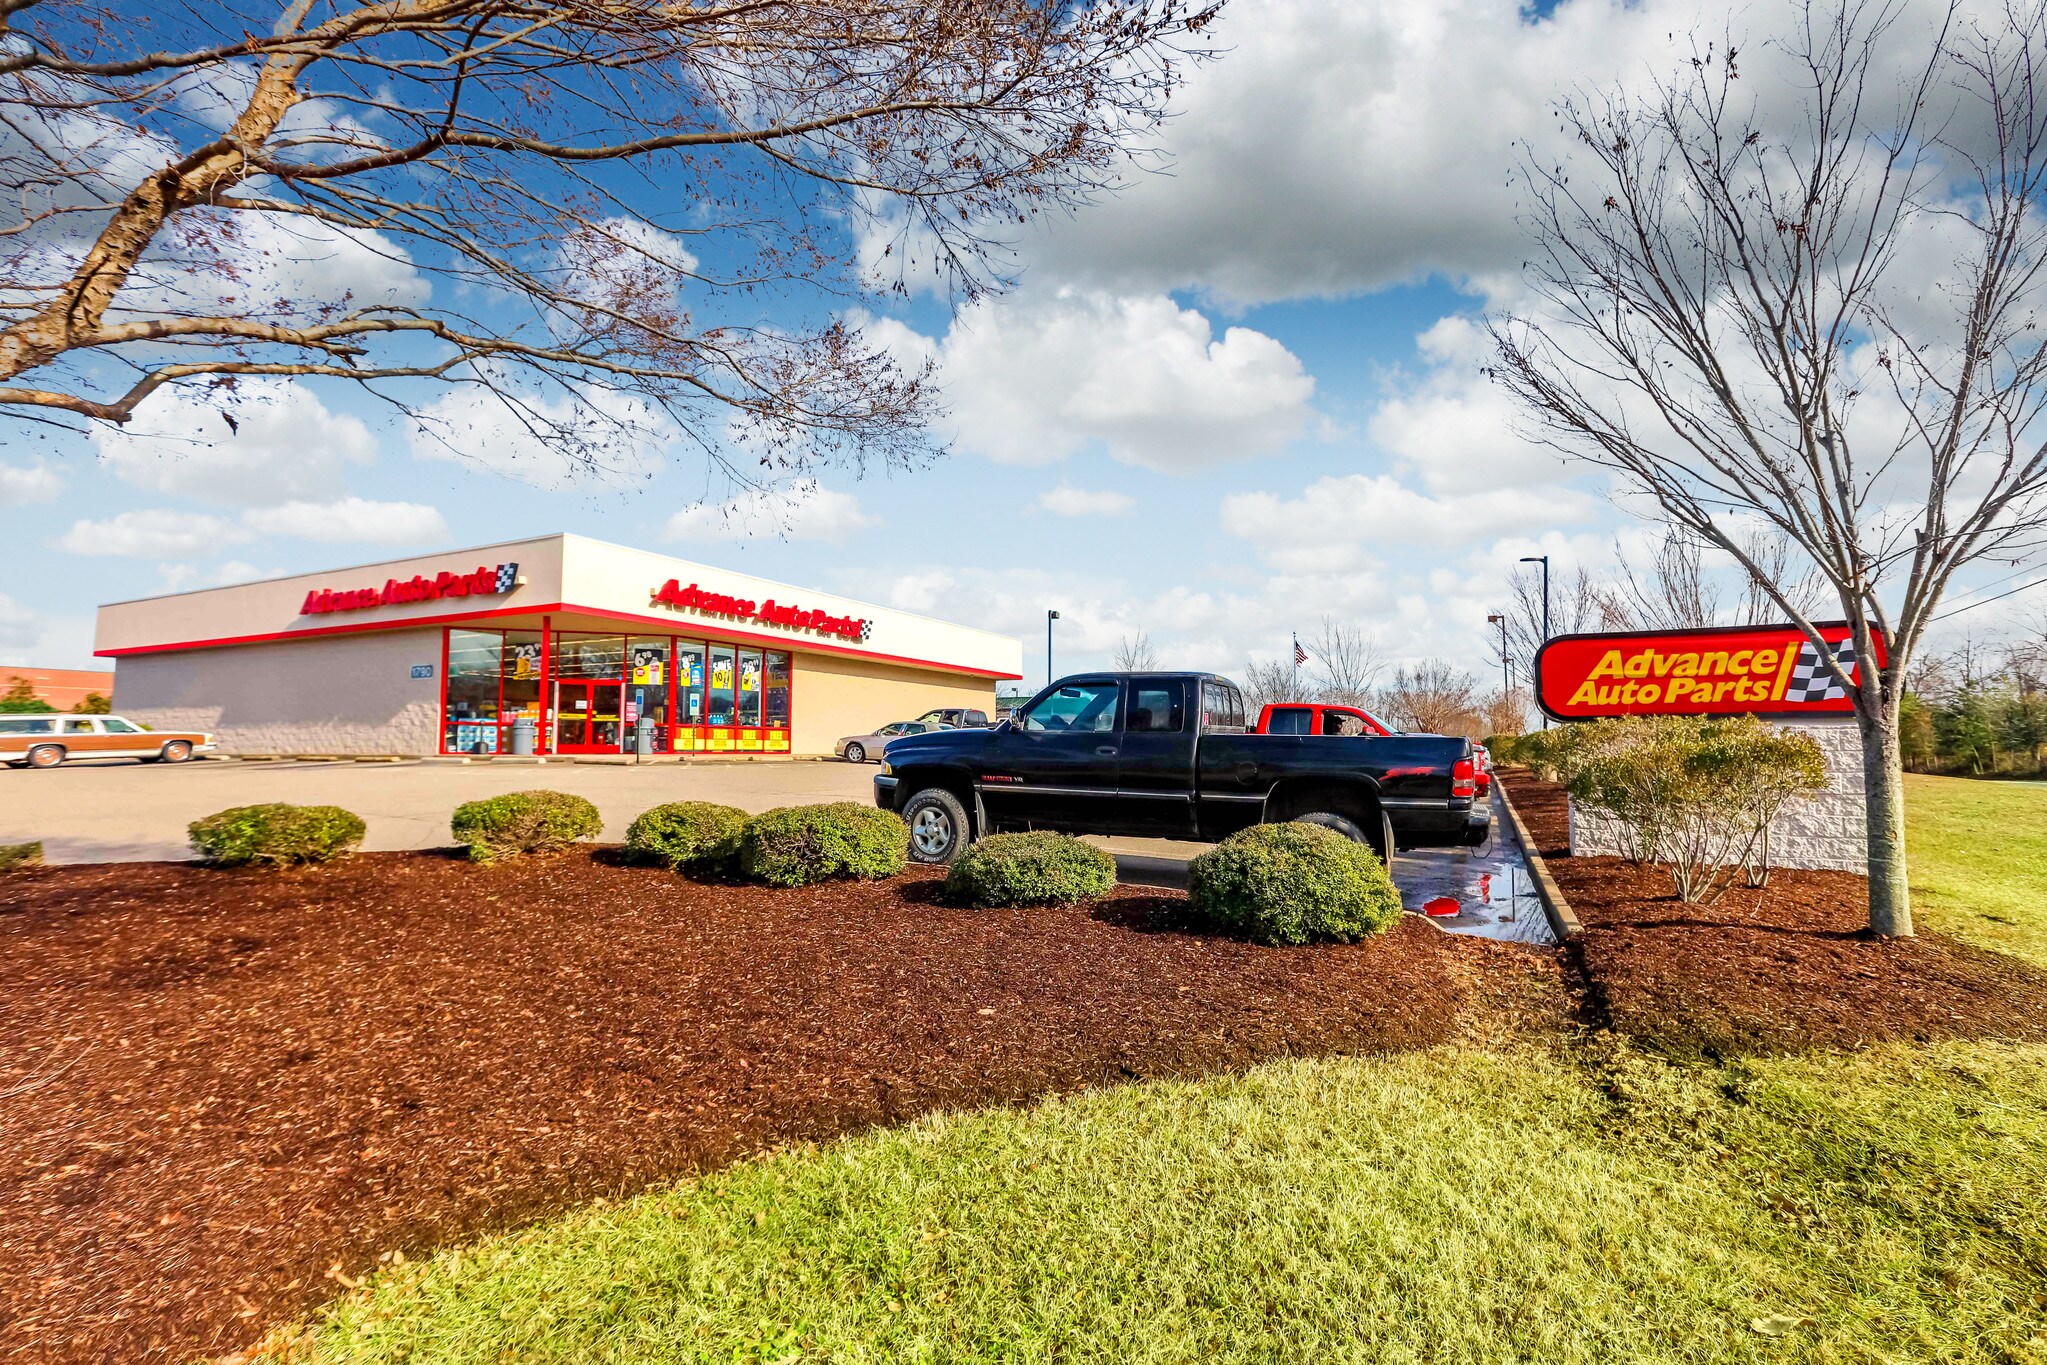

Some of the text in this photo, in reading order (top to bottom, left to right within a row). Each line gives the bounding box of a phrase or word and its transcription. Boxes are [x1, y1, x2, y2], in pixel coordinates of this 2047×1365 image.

[655, 579, 756, 618] Advance
[758, 599, 809, 627] Auto
[1587, 648, 1778, 680] Advance
[1566, 677, 1772, 706] Auto Parts
